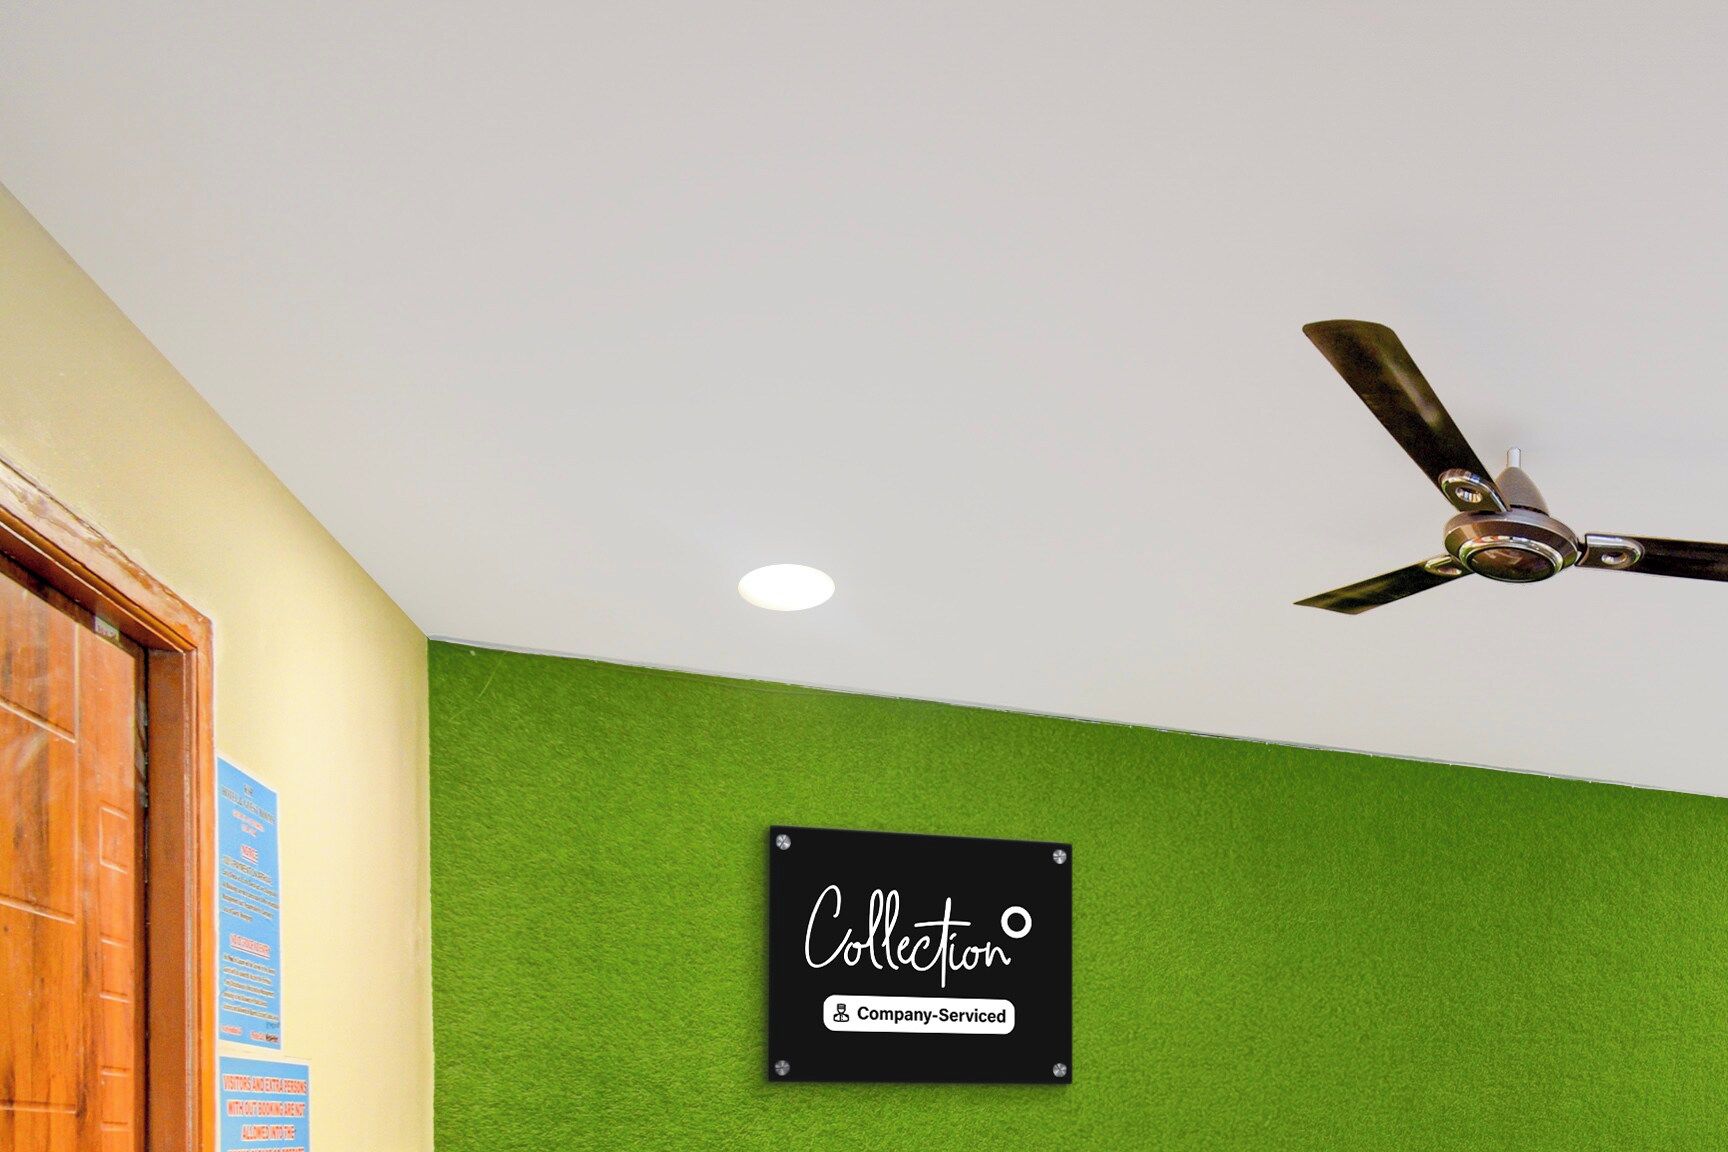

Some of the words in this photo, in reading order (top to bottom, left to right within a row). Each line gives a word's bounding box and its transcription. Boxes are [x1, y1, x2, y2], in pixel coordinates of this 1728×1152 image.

[804, 883, 1012, 989] Collection
[857, 1005, 1007, 1026] Company-Serviced
[223, 1075, 251, 1091] VISITORS
[252, 1077, 264, 1092] AND
[265, 1077, 283, 1093] EXTRA
[283, 1079, 308, 1094] PERSONS
[227, 1100, 244, 1115] WITH
[258, 1101, 283, 1116] BOOKING
[284, 1102, 294, 1116] ARE
[241, 1125, 269, 1140] ALLOWED
